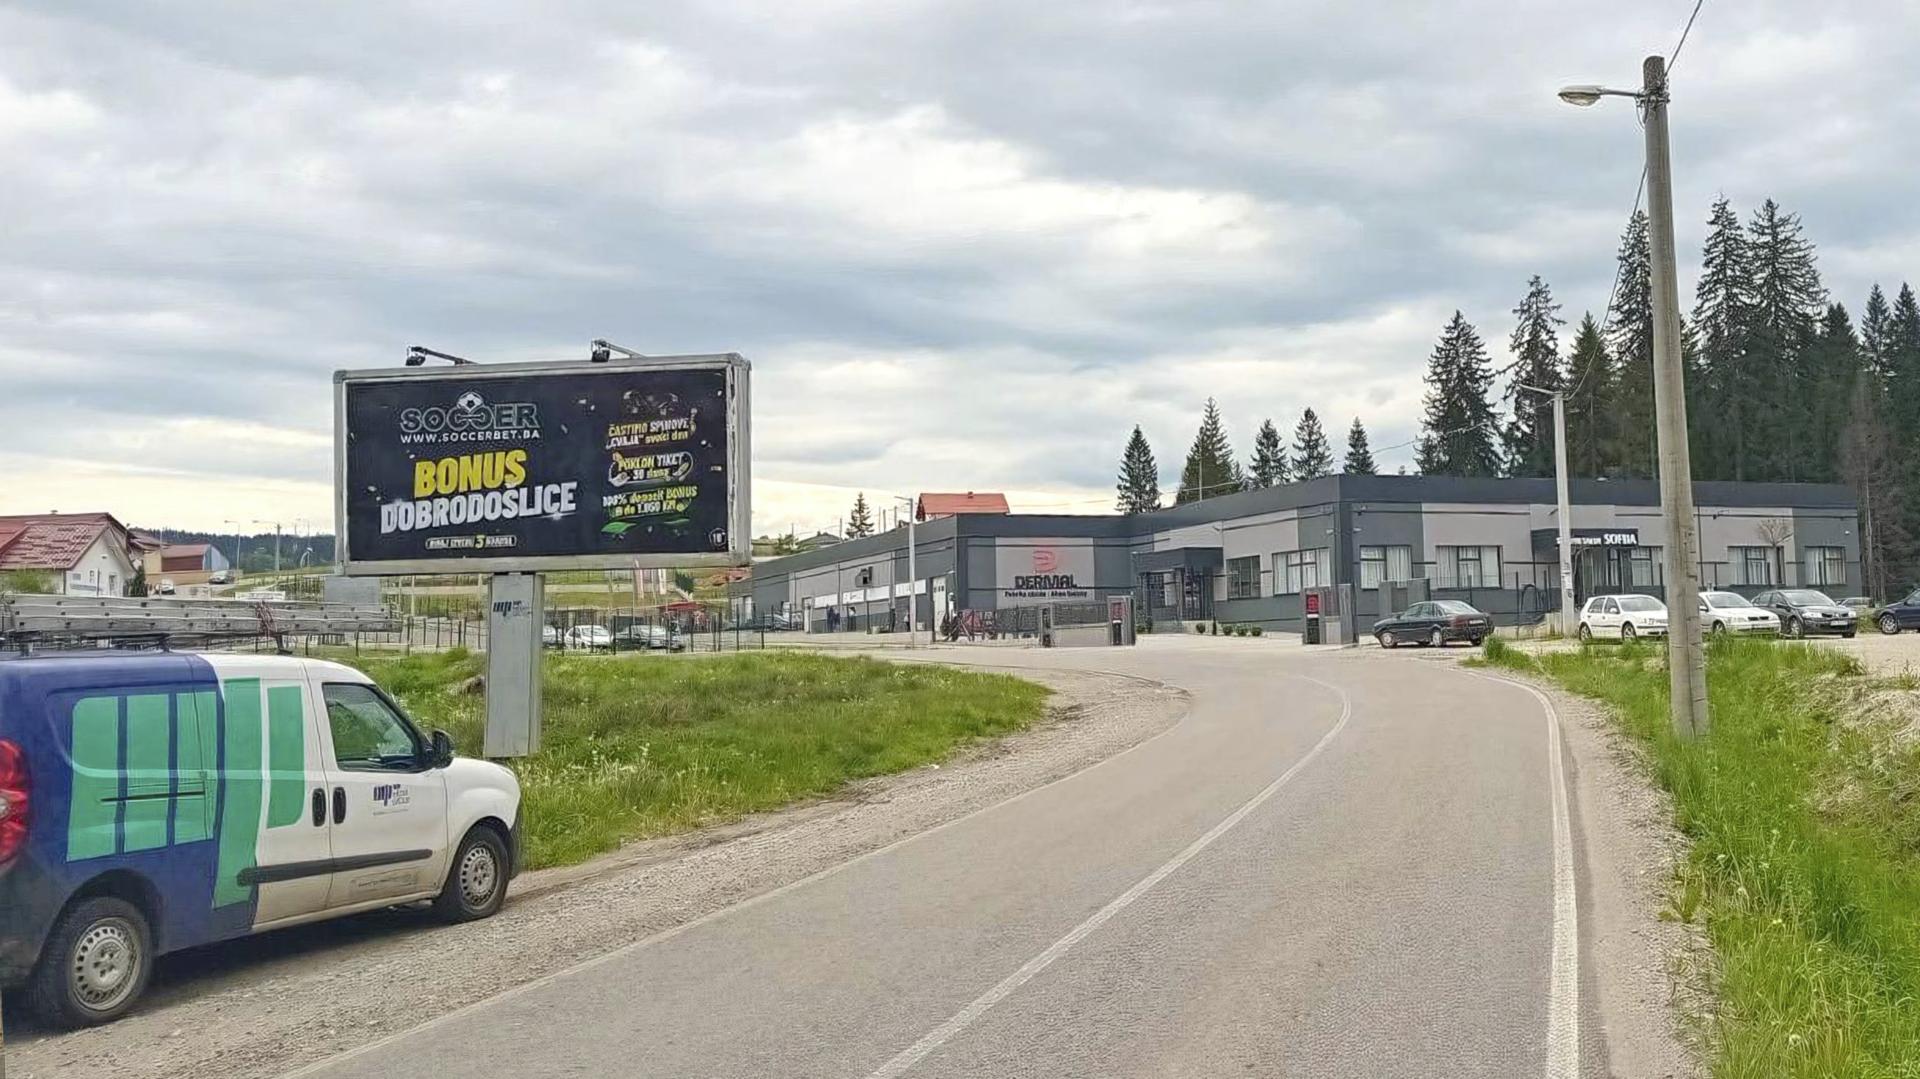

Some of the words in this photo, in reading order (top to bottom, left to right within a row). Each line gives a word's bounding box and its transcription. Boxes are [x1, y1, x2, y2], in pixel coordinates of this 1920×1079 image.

[414, 449, 527, 498] BONUS
[665, 485, 698, 499] BONUS
[1015, 574, 1078, 590] DERMAL
